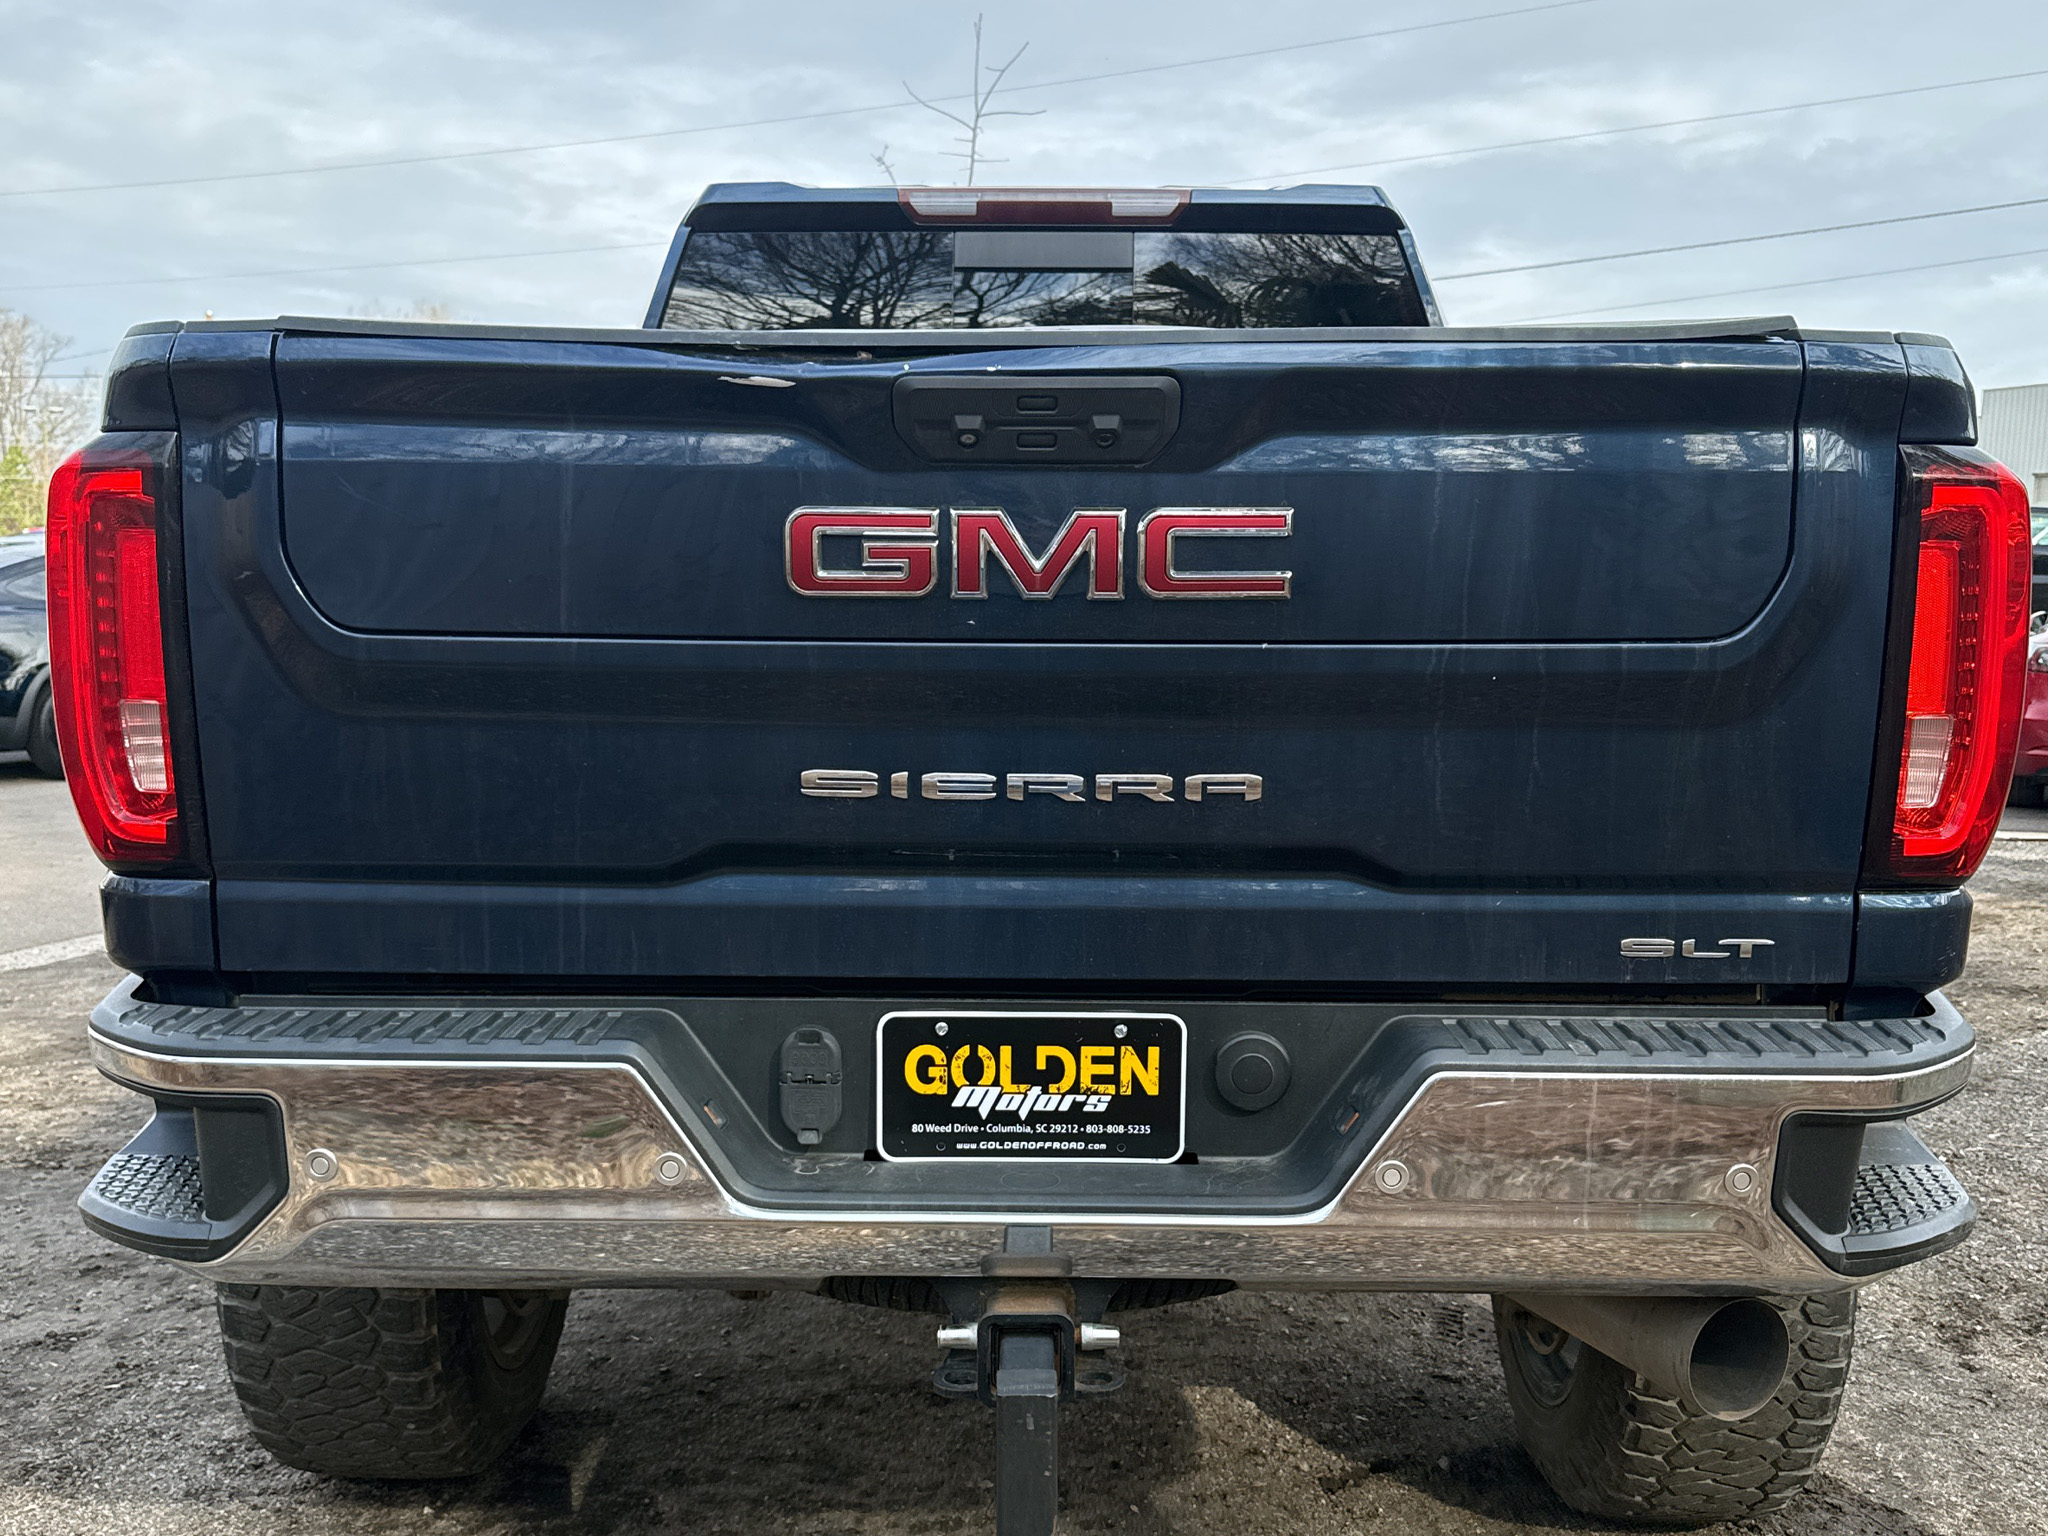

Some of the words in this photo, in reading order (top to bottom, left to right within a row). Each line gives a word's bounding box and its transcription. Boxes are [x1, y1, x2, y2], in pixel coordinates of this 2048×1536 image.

[785, 506, 1294, 600] GMC
[800, 768, 1263, 803] SIERRA
[1620, 937, 1775, 959] SLT
[904, 1044, 1160, 1096] GOLDEN
[951, 1086, 1112, 1120] Motors
[911, 1123, 924, 1133] 80
[925, 1123, 952, 1133] Weed
[953, 1123, 979, 1133] Drive
[986, 1123, 1034, 1135] Columbia,
[1035, 1123, 1048, 1134] SC
[1049, 1124, 1079, 1134] 29212
[1085, 1124, 1151, 1135] 803-808-5235
